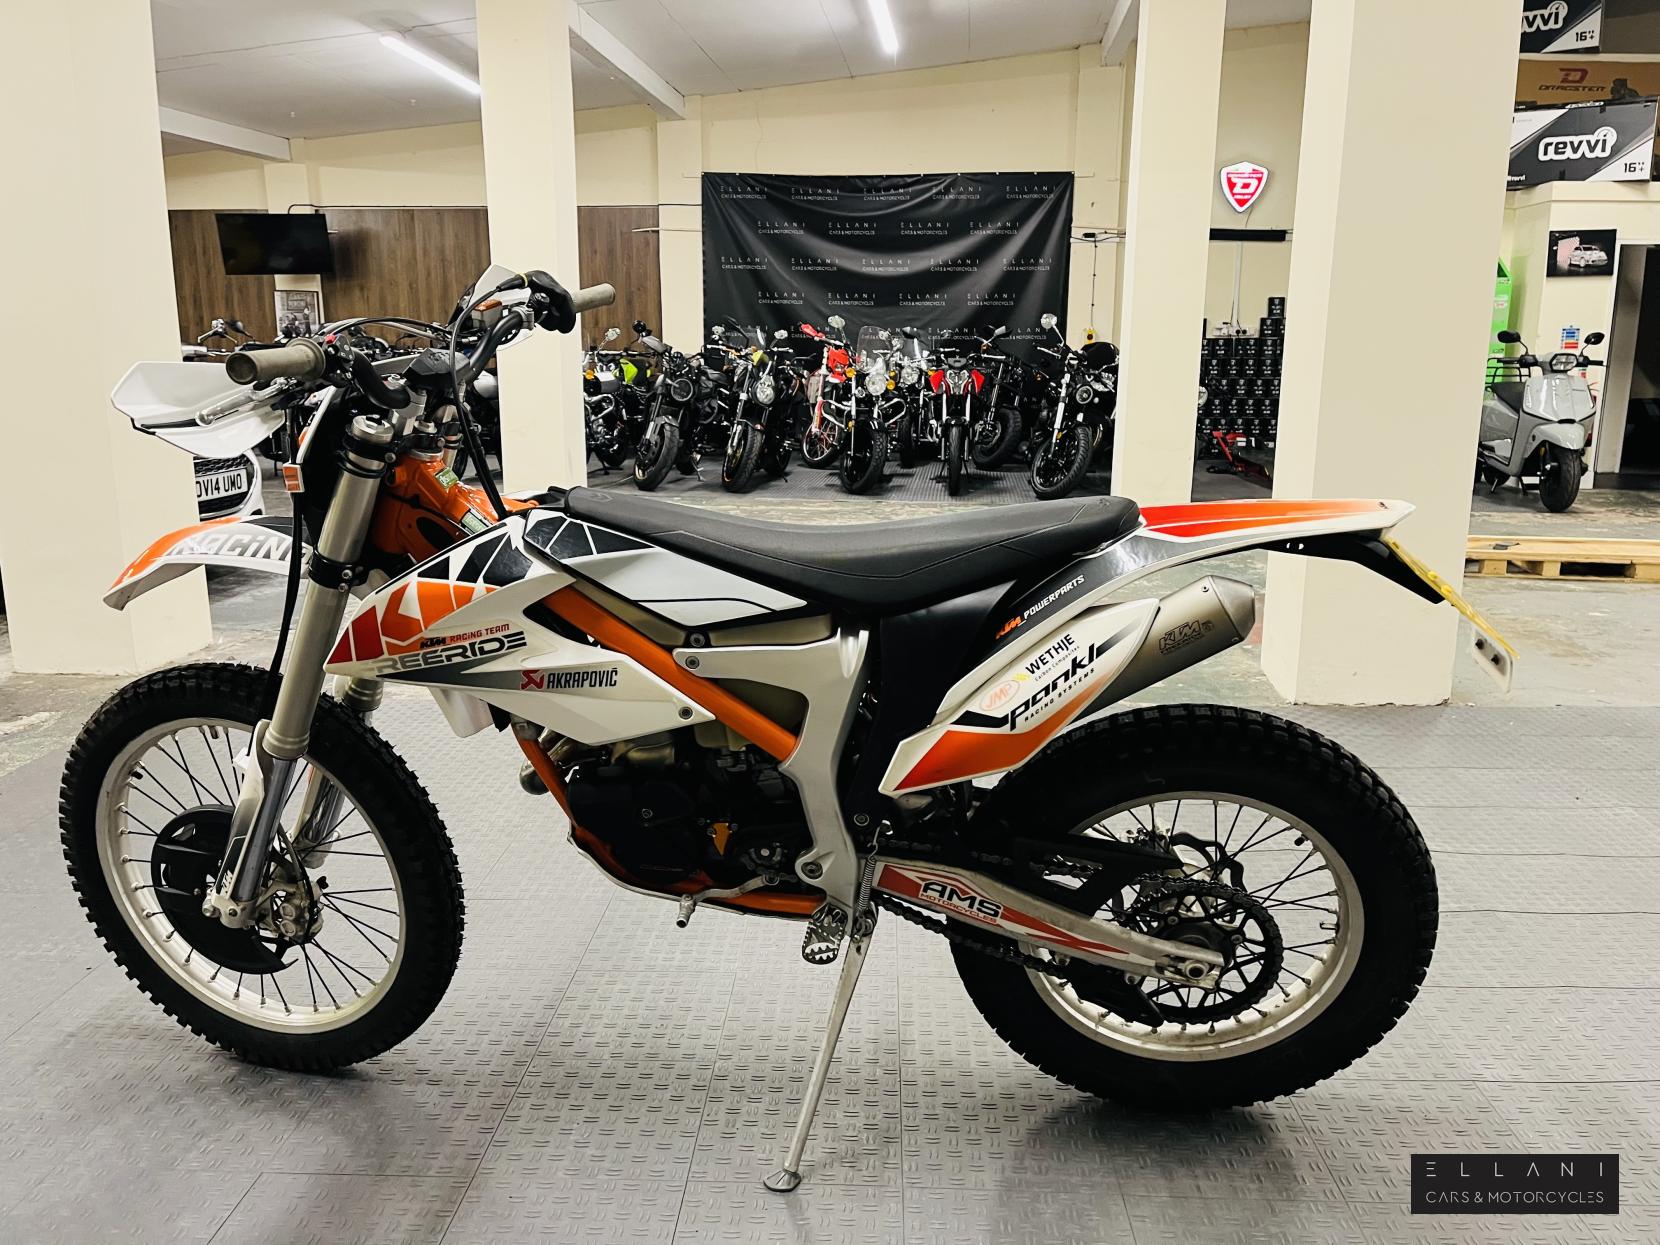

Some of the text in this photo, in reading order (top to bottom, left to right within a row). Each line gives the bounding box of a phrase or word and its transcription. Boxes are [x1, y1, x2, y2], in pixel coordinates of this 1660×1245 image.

[1542, 132, 1608, 156] revvi
[1024, 574, 1085, 620] POWERPARTS
[372, 630, 527, 674] REERIDE
[420, 637, 446, 649] KTM
[485, 623, 509, 636] TEAM
[1159, 620, 1202, 651] KTM
[1025, 634, 1075, 675] WETHJE
[546, 667, 618, 689] AKRAPOVIČ
[1024, 668, 1095, 722] RACING SYSTEMS
[920, 893, 997, 924] MOTORCYCLES
[922, 881, 1002, 918] AMS
